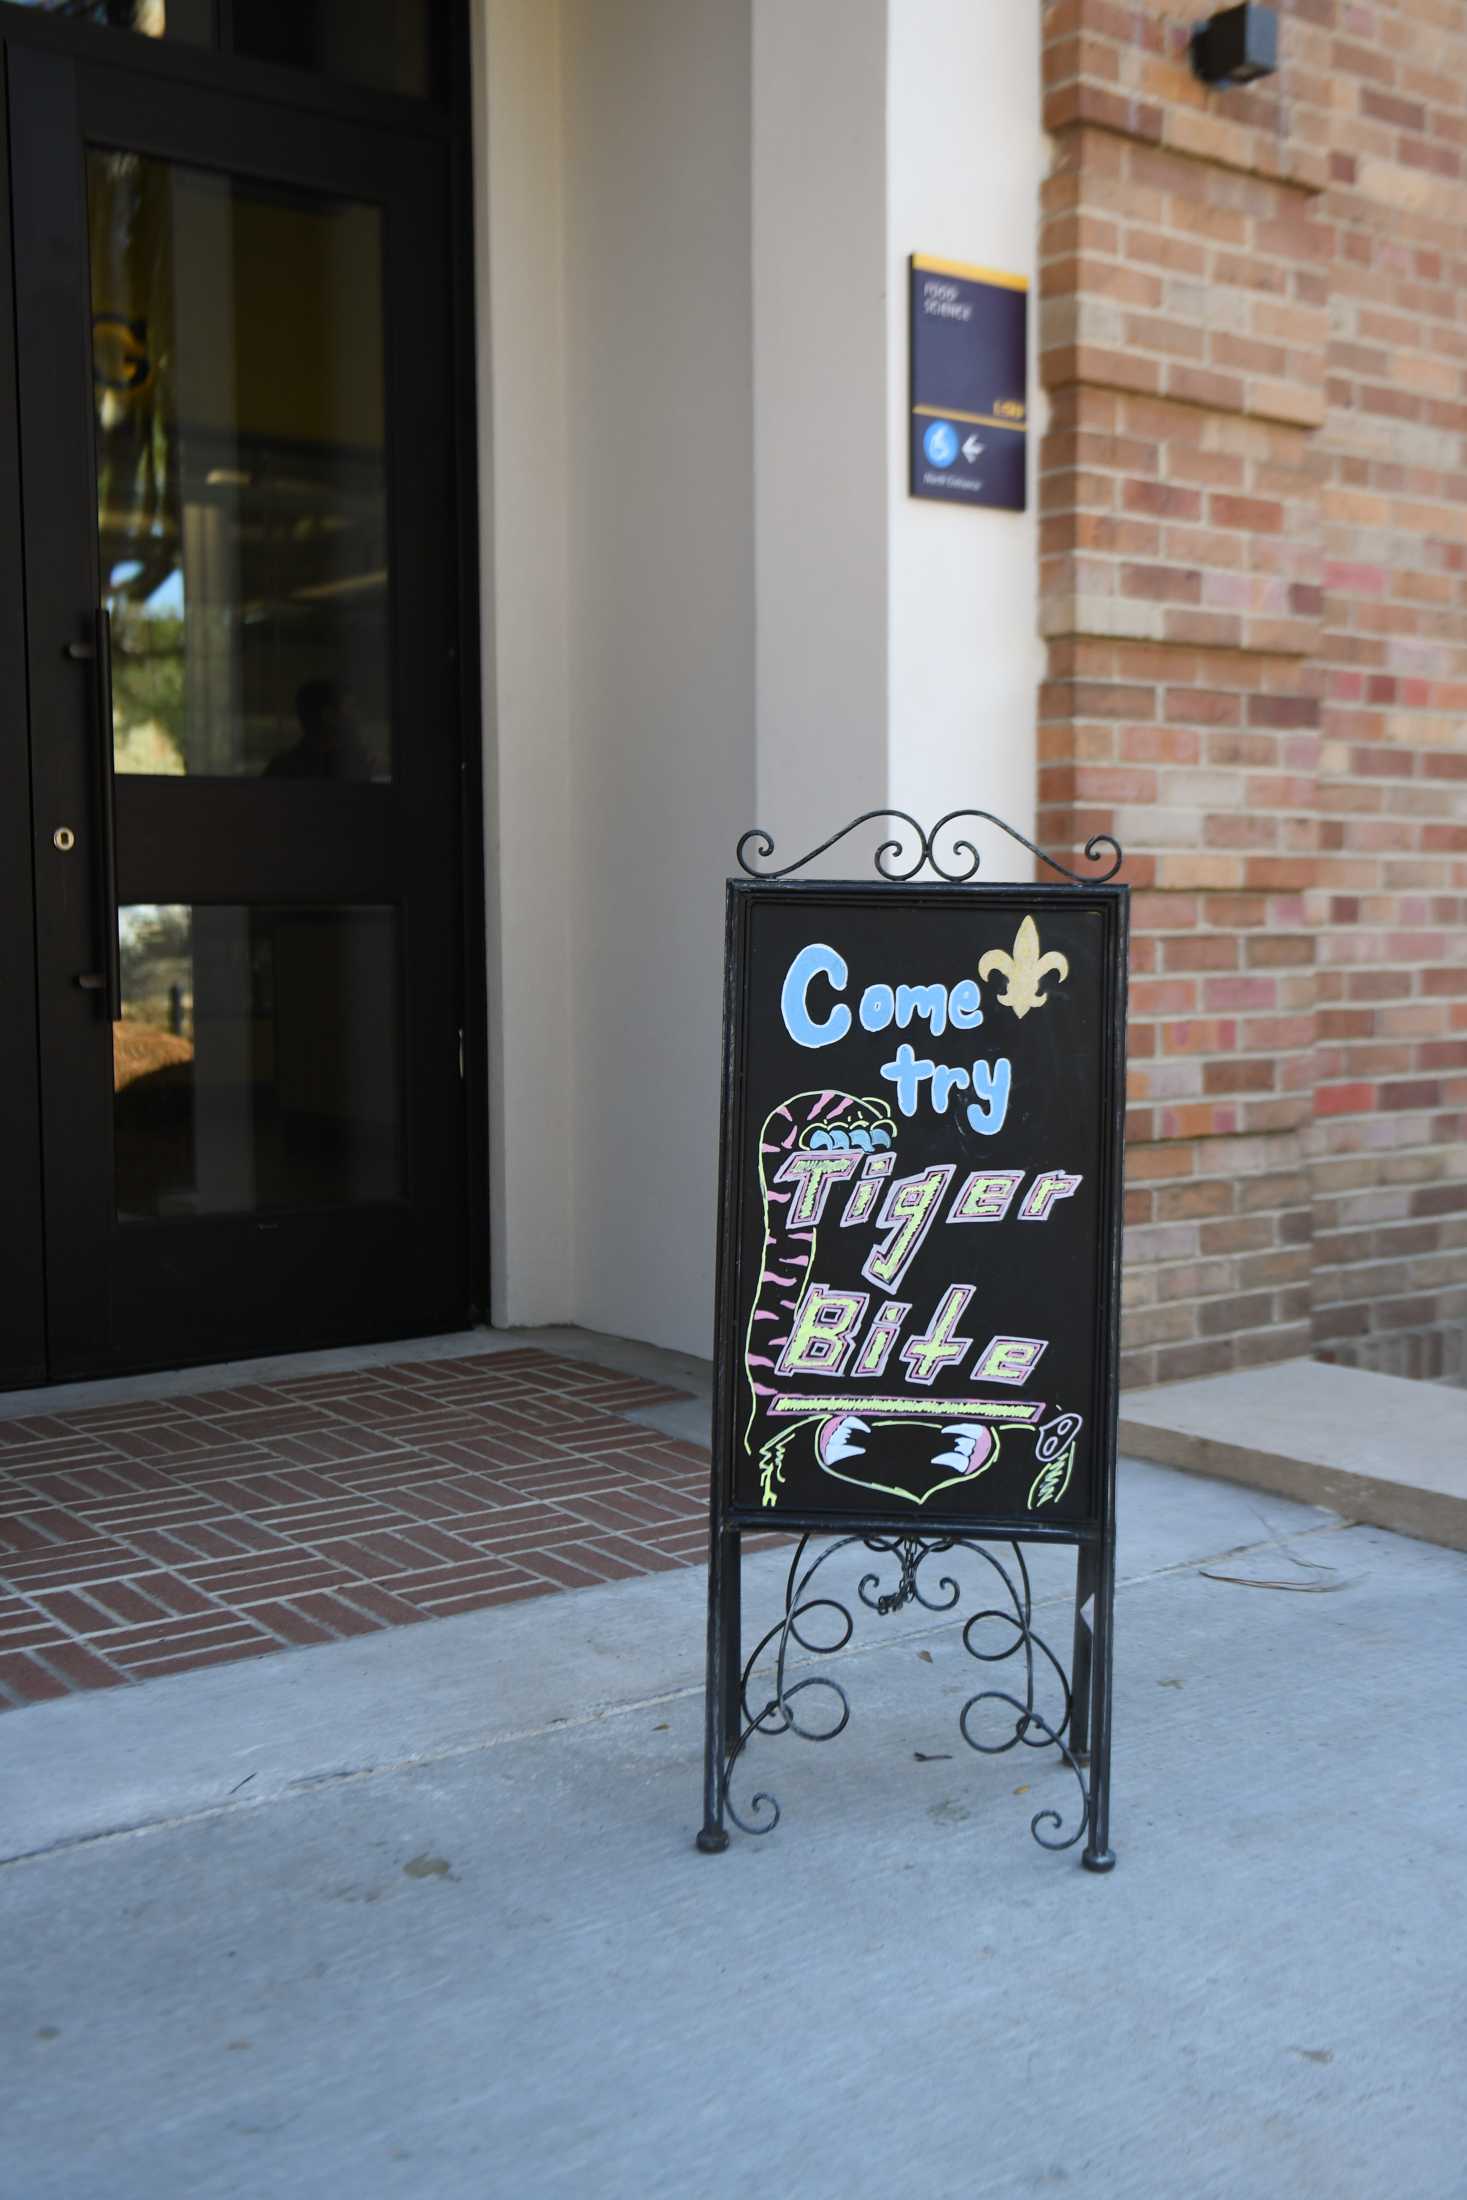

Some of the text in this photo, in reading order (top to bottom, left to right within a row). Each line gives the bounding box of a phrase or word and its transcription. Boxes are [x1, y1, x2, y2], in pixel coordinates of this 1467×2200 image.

[780, 943, 983, 1048] Come
[879, 1043, 1011, 1135] try
[773, 1149, 1083, 1294] Tiger
[774, 1283, 1049, 1386] Bite
